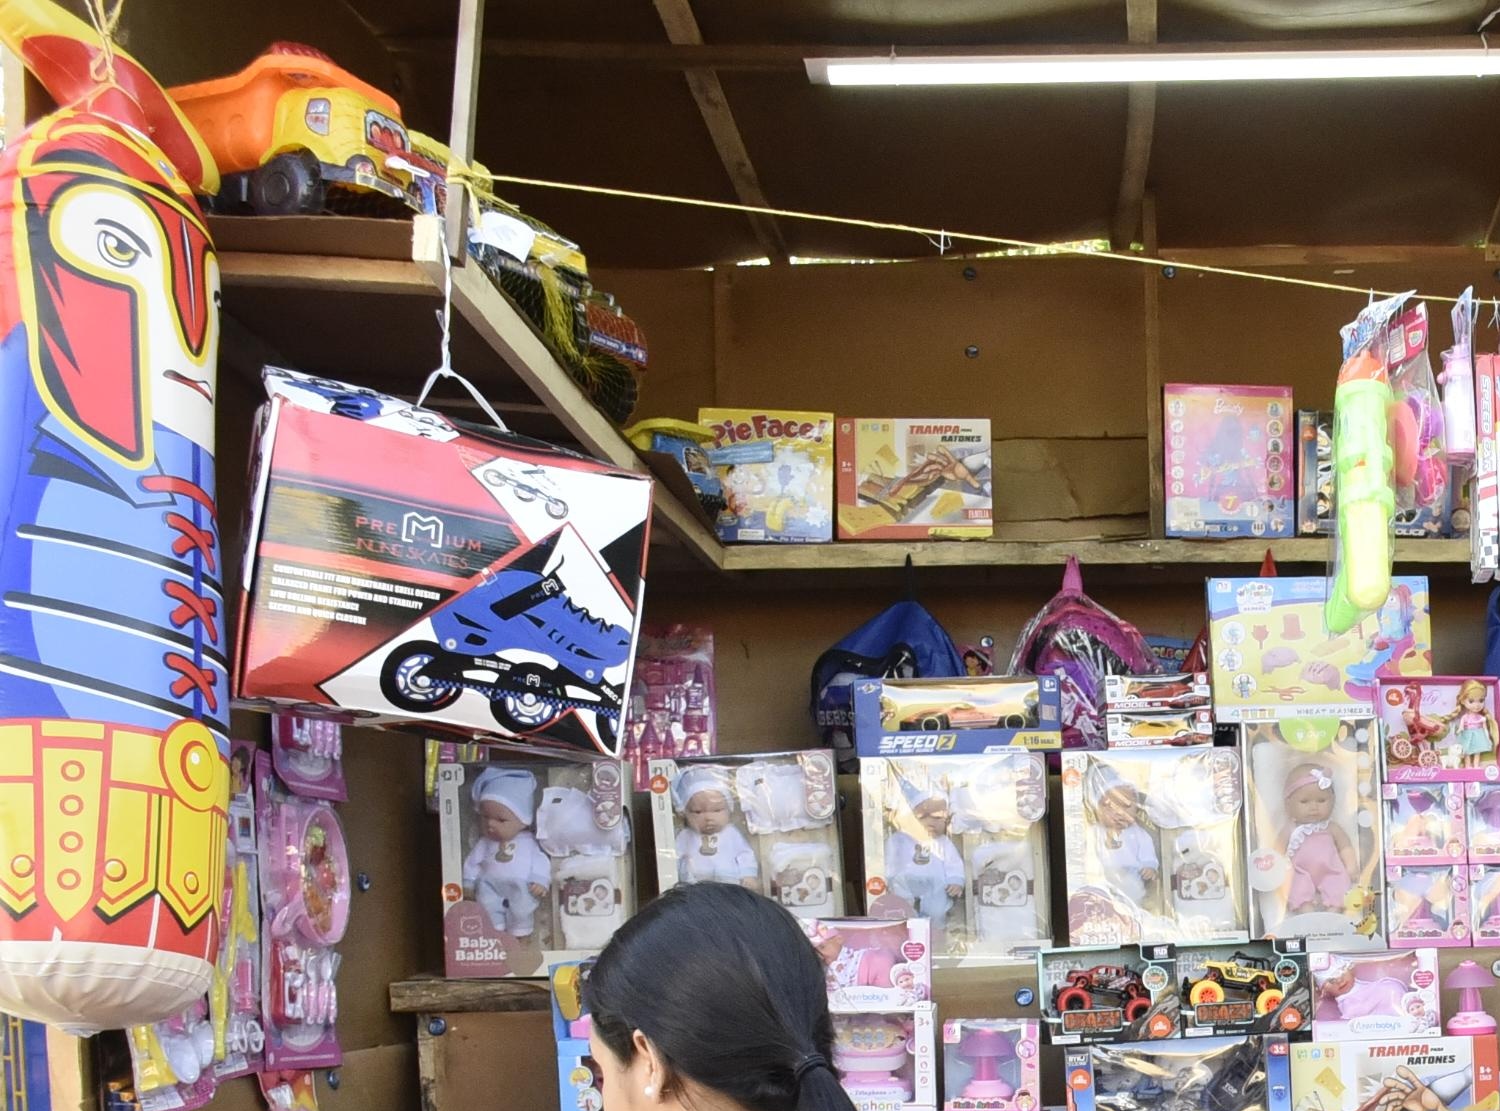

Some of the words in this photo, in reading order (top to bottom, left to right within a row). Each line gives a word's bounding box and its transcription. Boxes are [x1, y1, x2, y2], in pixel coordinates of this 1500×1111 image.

[709, 419, 750, 448] Pie
[751, 415, 828, 444] Face!
[909, 425, 960, 434] TRAMPA
[355, 511, 483, 552] PREMIUM
[1395, 528, 1426, 537] OLICE
[348, 587, 373, 601] POWER
[373, 592, 388, 604] AND
[388, 594, 423, 610] STABILITY
[335, 611, 368, 626] CLOSURE
[1114, 701, 1151, 709] MODEL
[880, 735, 938, 749] SPEED
[1115, 739, 1151, 747] MODEL
[458, 936, 499, 952] Baby
[455, 949, 507, 962] Babble
[1368, 1044, 1430, 1058] TRAMPA
[1407, 1055, 1456, 1066] RATONES
